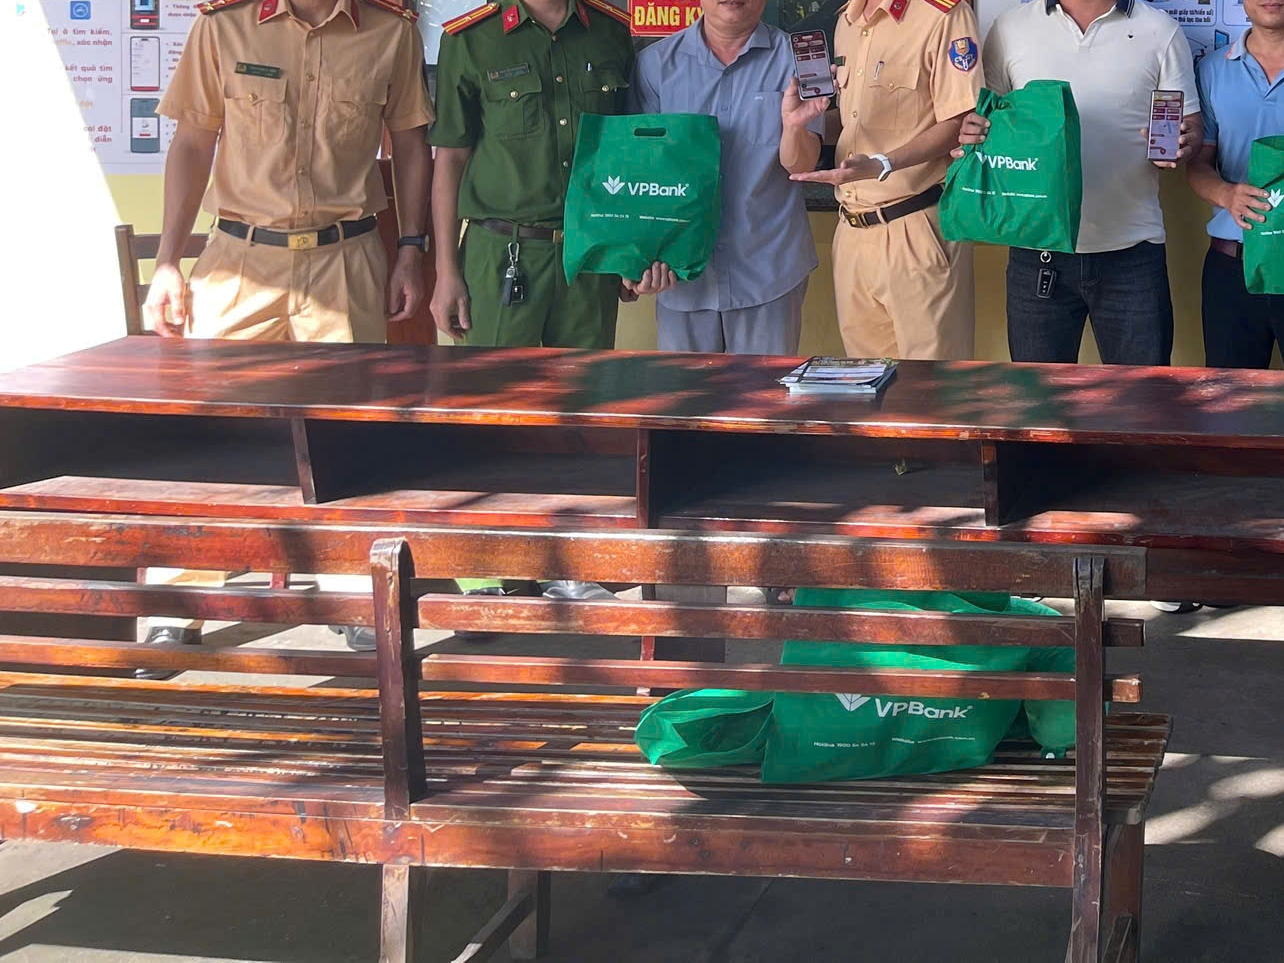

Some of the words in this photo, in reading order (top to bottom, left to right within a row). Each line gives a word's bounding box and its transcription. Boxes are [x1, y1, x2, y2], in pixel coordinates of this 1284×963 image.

[634, 2, 680, 26] ĐĂNG
[988, 155, 1037, 170] VPBank
[628, 182, 686, 196] VPBank
[875, 697, 969, 719] VPBank
